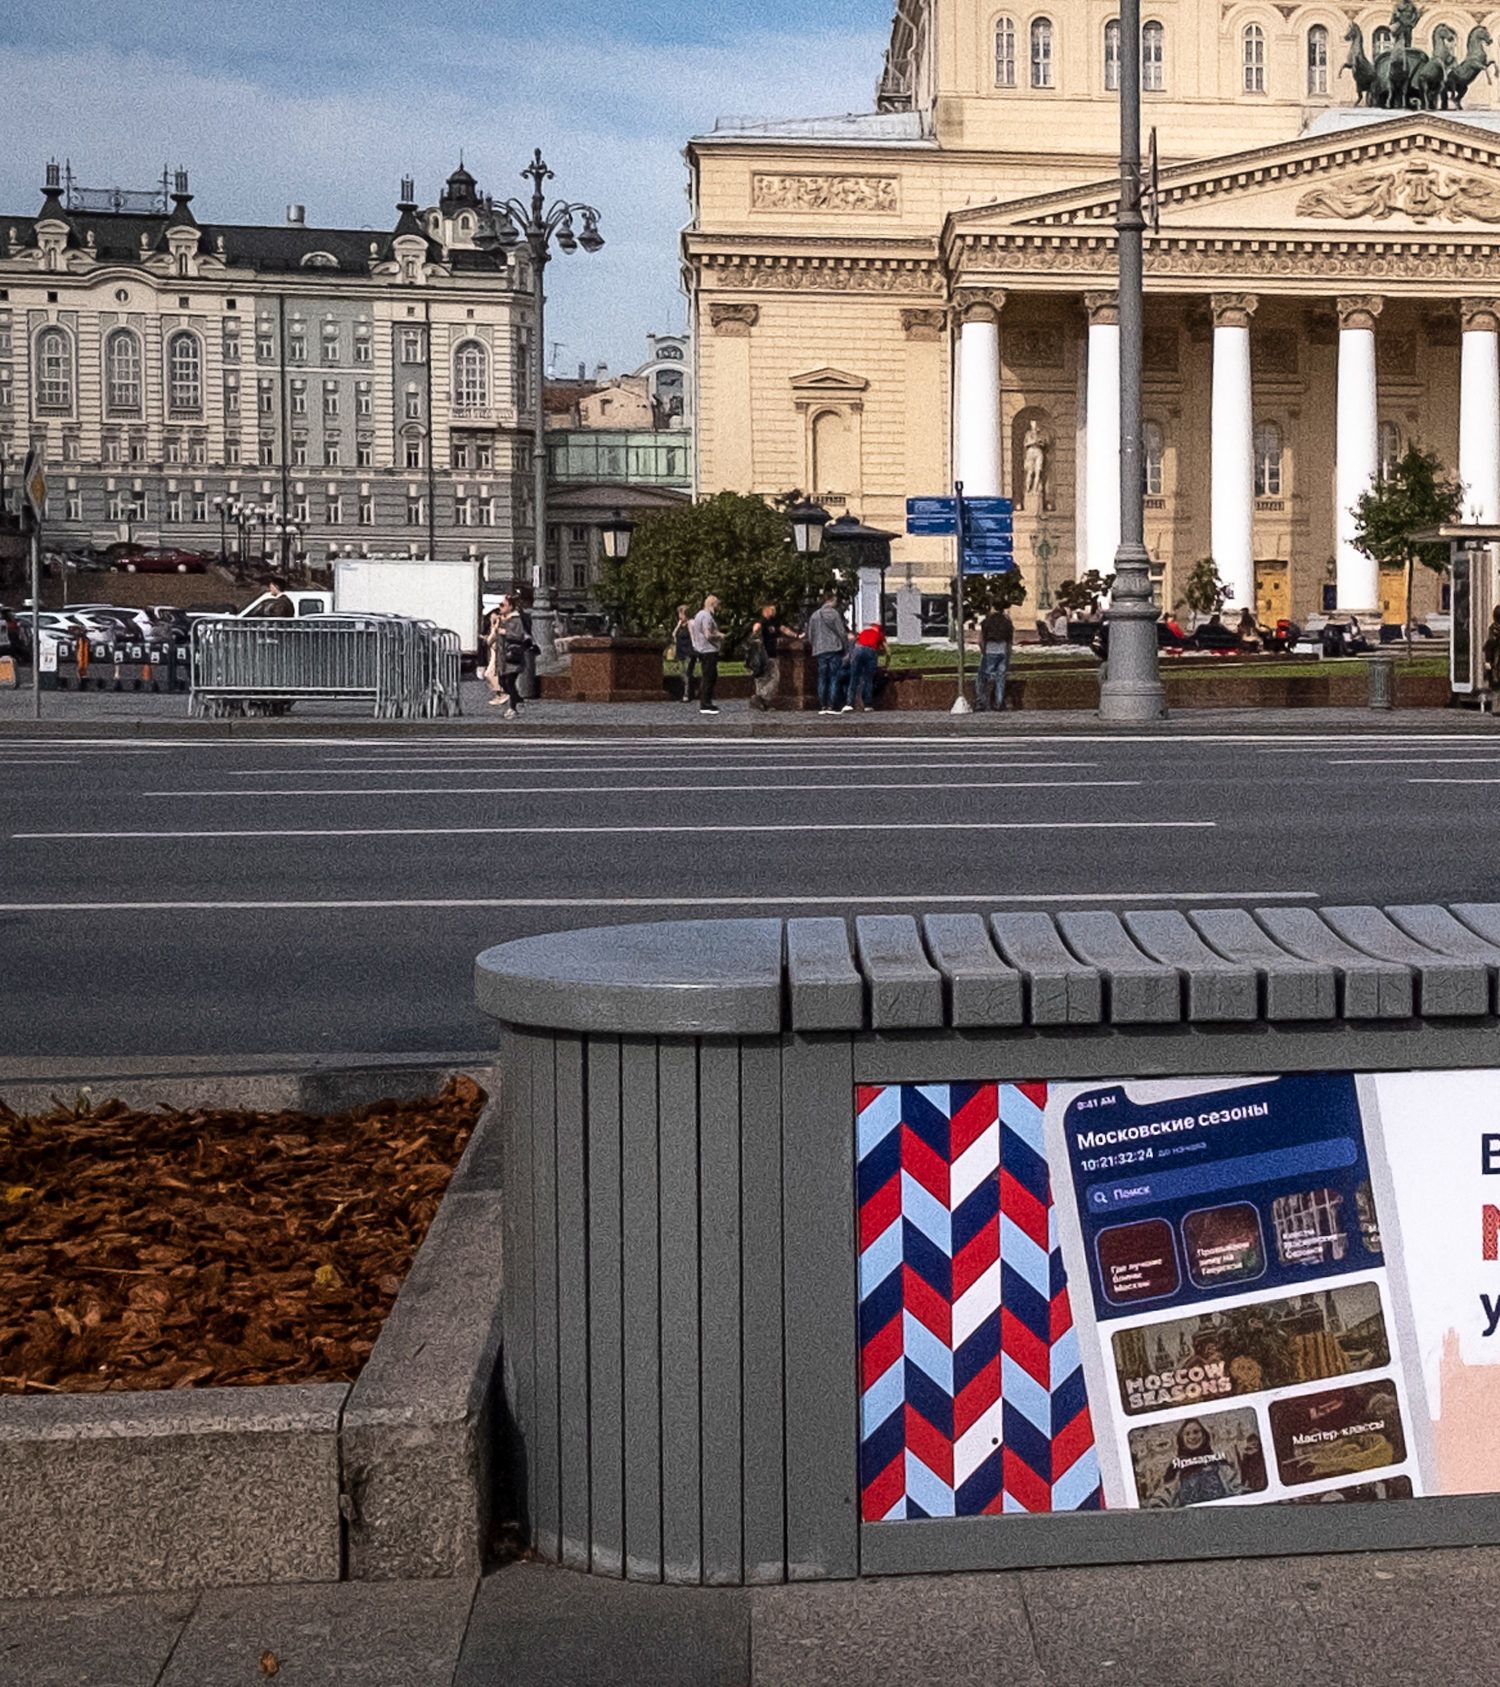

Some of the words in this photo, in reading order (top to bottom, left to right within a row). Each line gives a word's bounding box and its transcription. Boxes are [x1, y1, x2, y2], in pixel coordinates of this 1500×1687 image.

[1100, 1095, 1117, 1107] AM
[1077, 1114, 1195, 1150] Московские
[1198, 1102, 1269, 1128] сезоны
[1081, 1147, 1154, 1172] 10:21:32:24
[1113, 1185, 1150, 1200] Поиск
[1125, 1360, 1226, 1395] MOSCOW
[1128, 1376, 1233, 1409] SEASONS
[1292, 1419, 1385, 1445] Мастер-классы
[1172, 1450, 1227, 1470] Ярмарки
